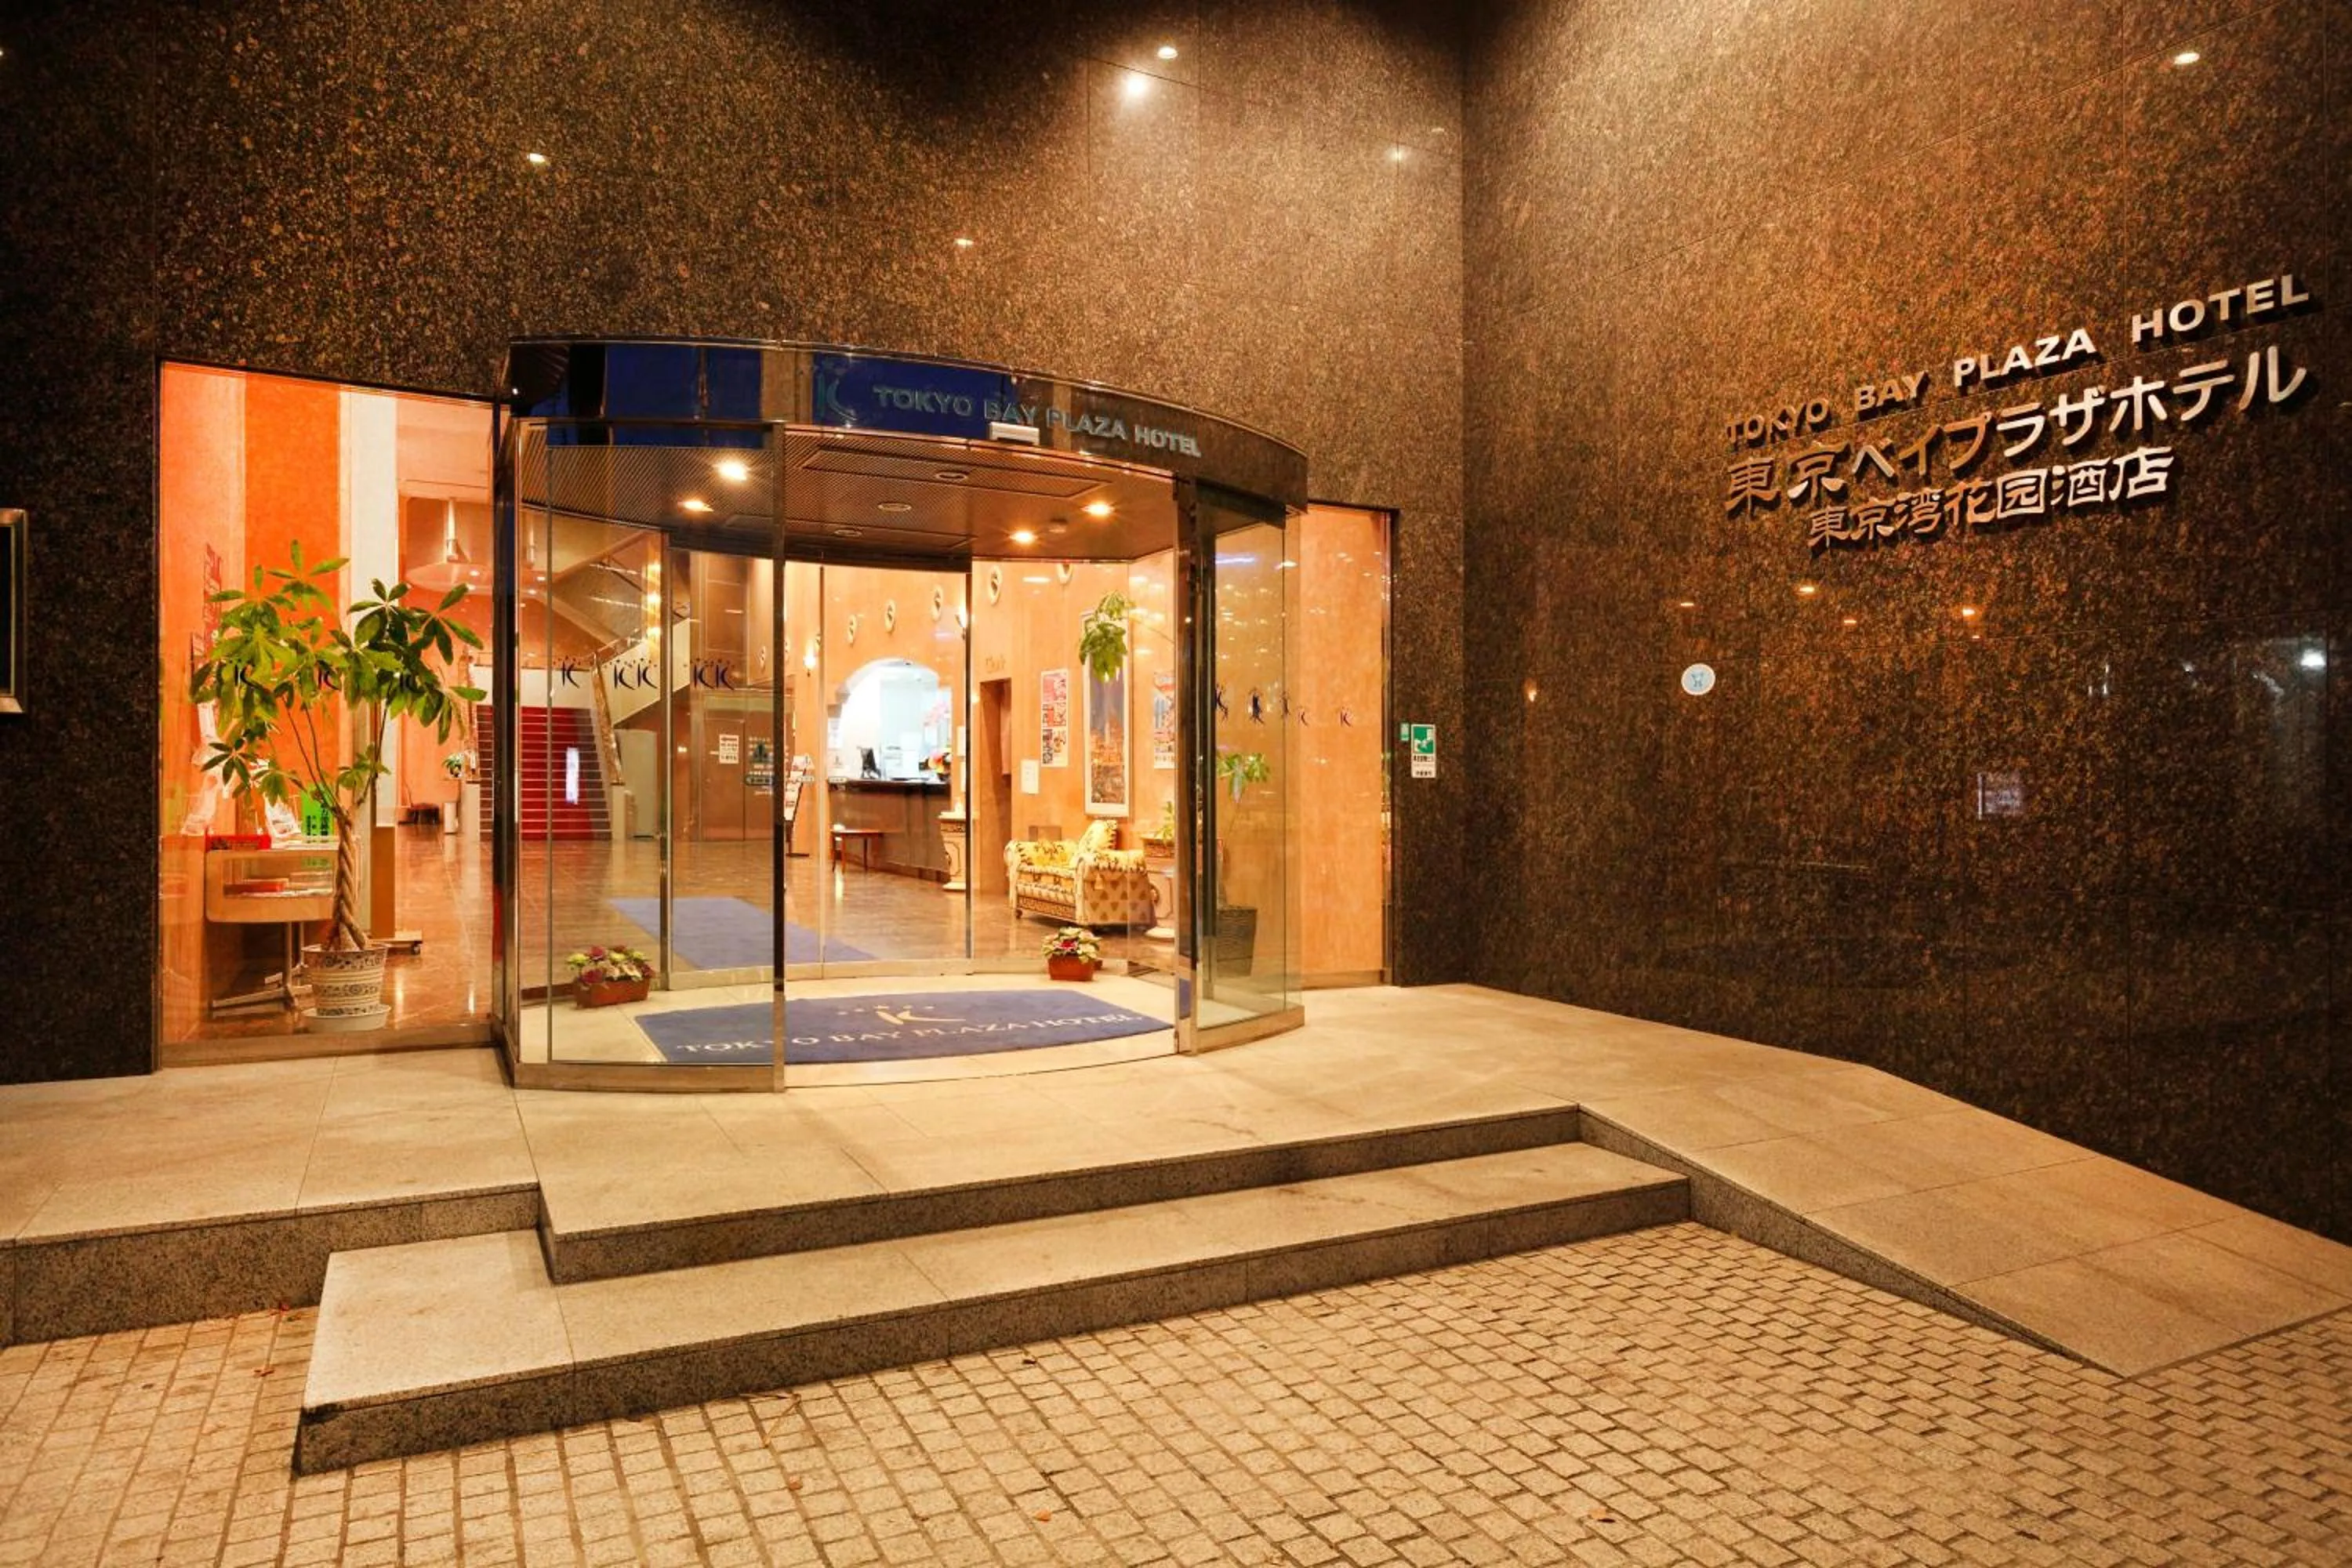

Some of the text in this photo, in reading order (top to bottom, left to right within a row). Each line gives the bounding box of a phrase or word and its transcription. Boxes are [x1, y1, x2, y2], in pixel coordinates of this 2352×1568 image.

[1726, 274, 2310, 445] TOKYO BAY PLAZA HOTEL
[872, 384, 1202, 458] TOKYO BAY PLAZA HOTEL
[1725, 345, 2307, 514] 東京ベイプラザホテル
[1808, 446, 2174, 548] 東京湾花园酒店
[829, 1030, 902, 1043] BAY
